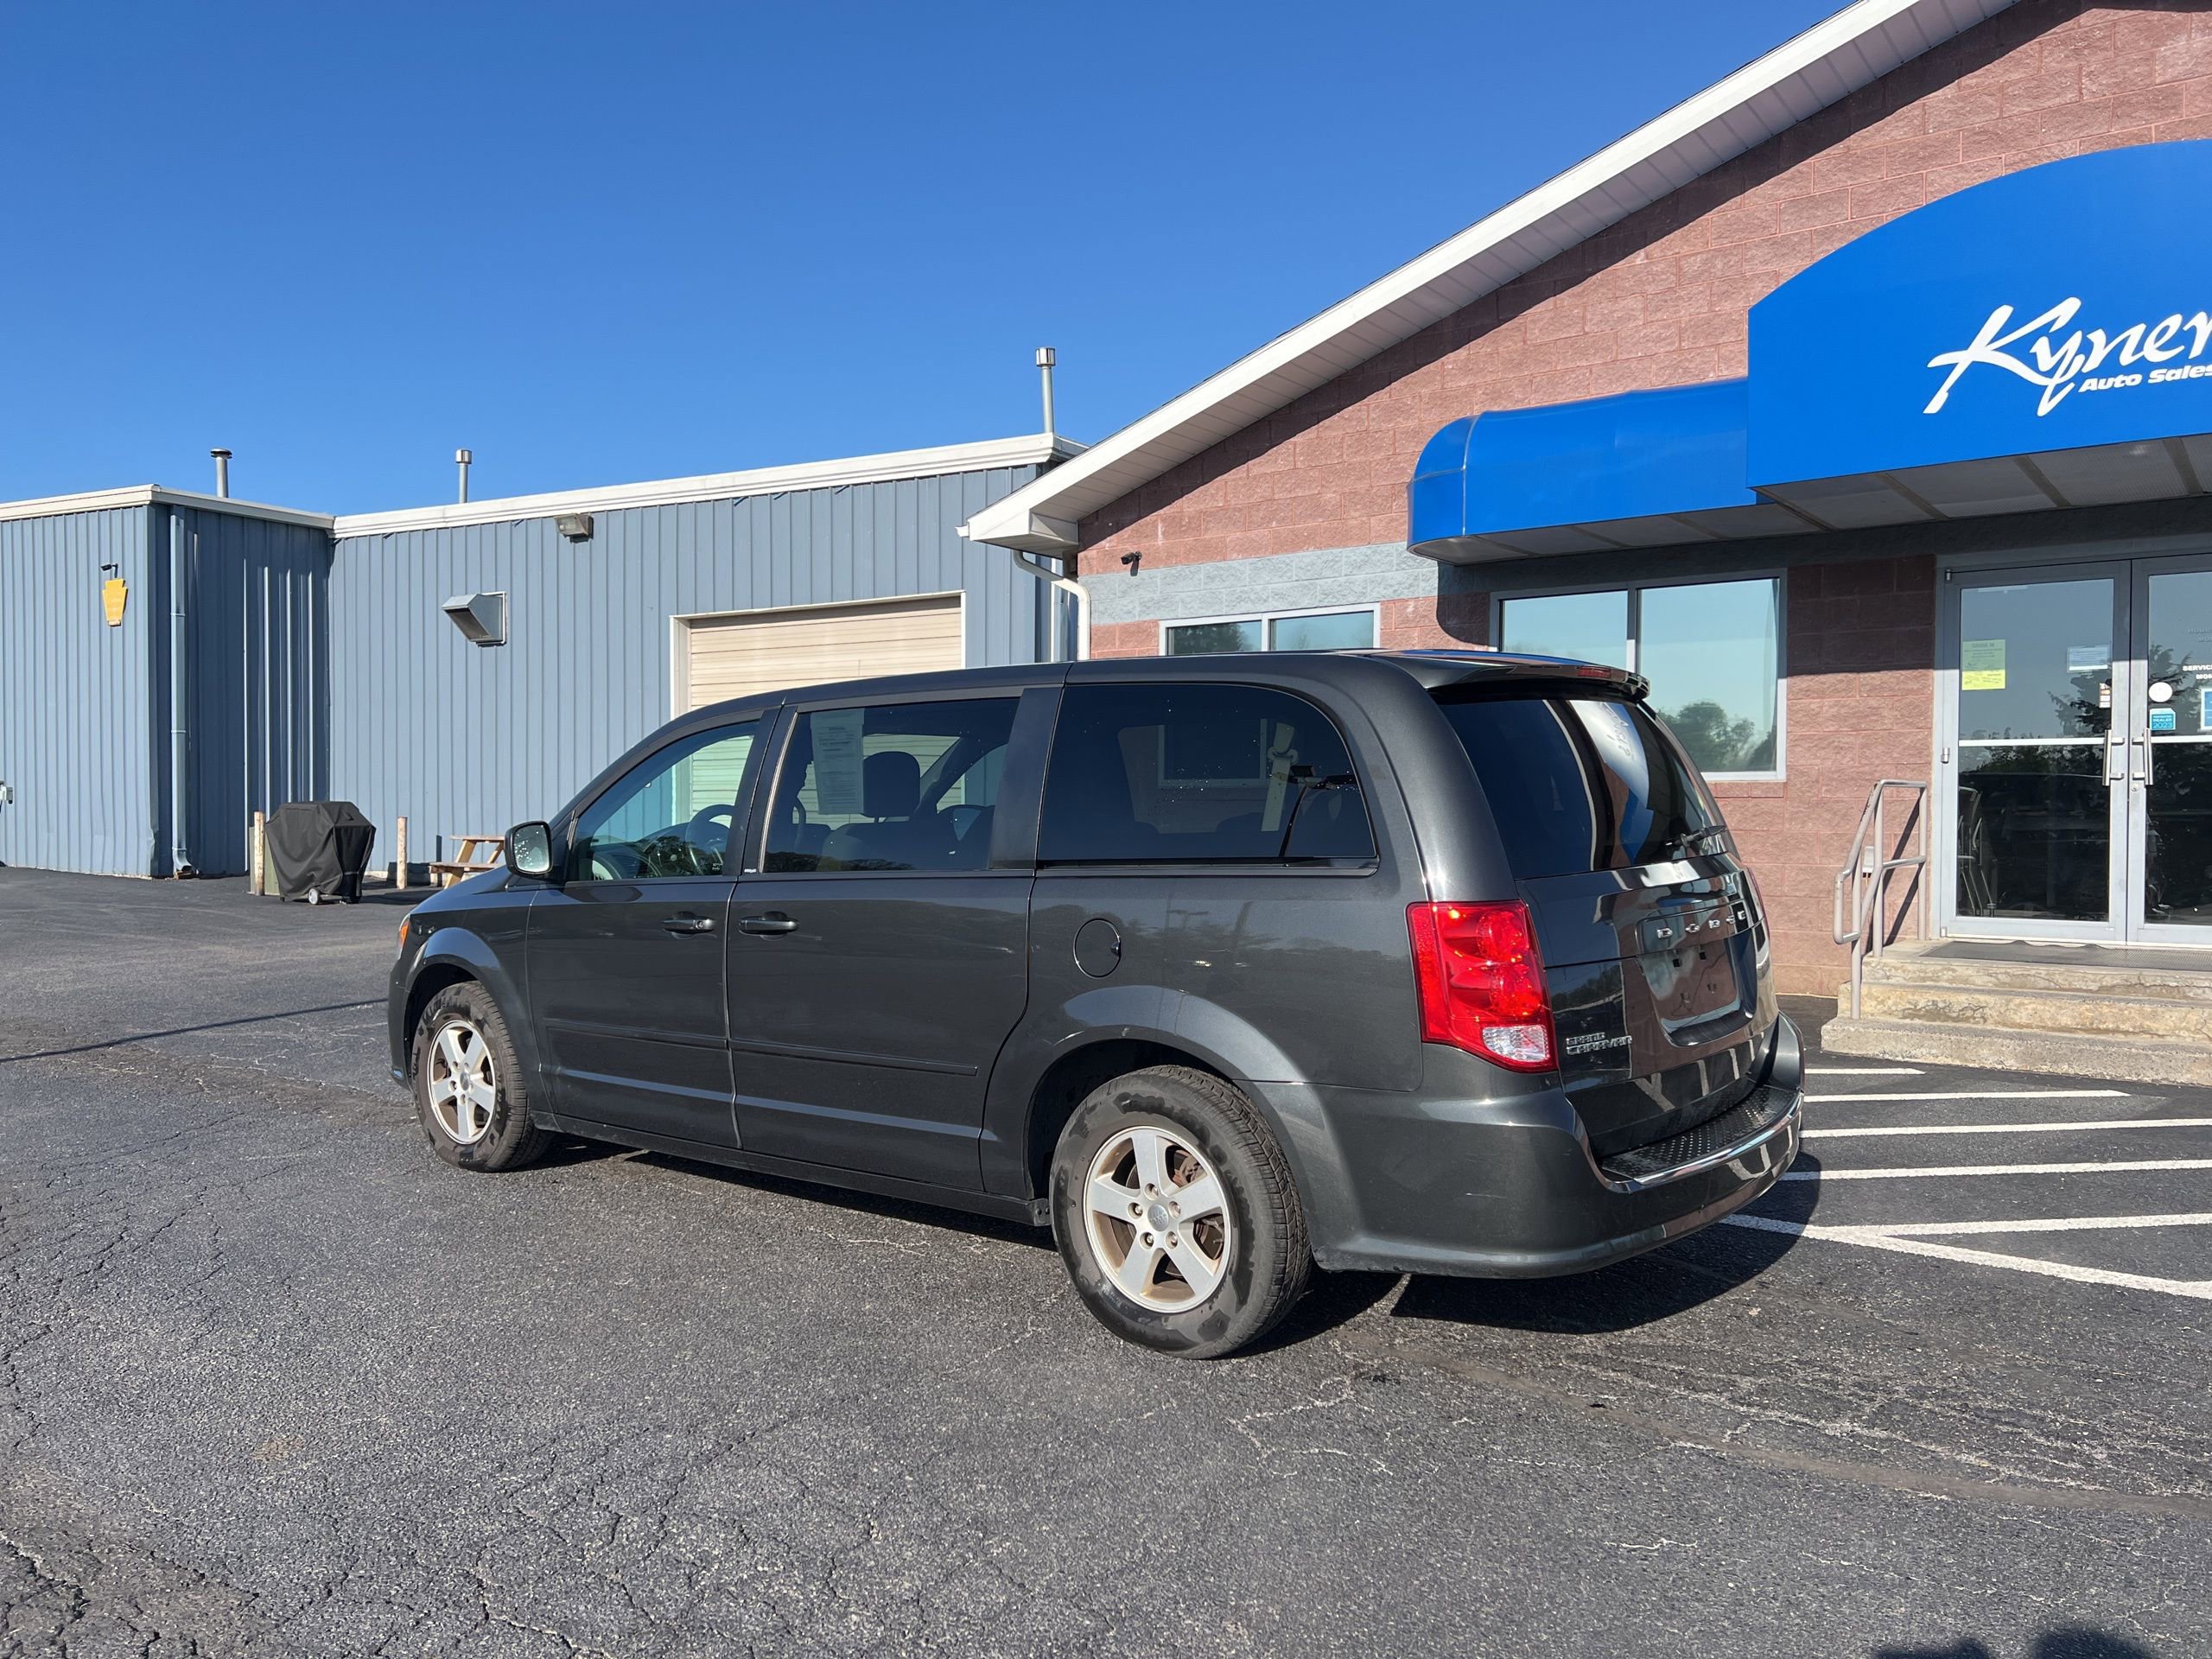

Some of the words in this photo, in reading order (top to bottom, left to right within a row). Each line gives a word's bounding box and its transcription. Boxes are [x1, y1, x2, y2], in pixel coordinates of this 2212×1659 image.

[2078, 374, 2142, 393] Auto
[1657, 910, 1746, 939] DODGE
[1566, 1035, 1632, 1055] CARAVAN
